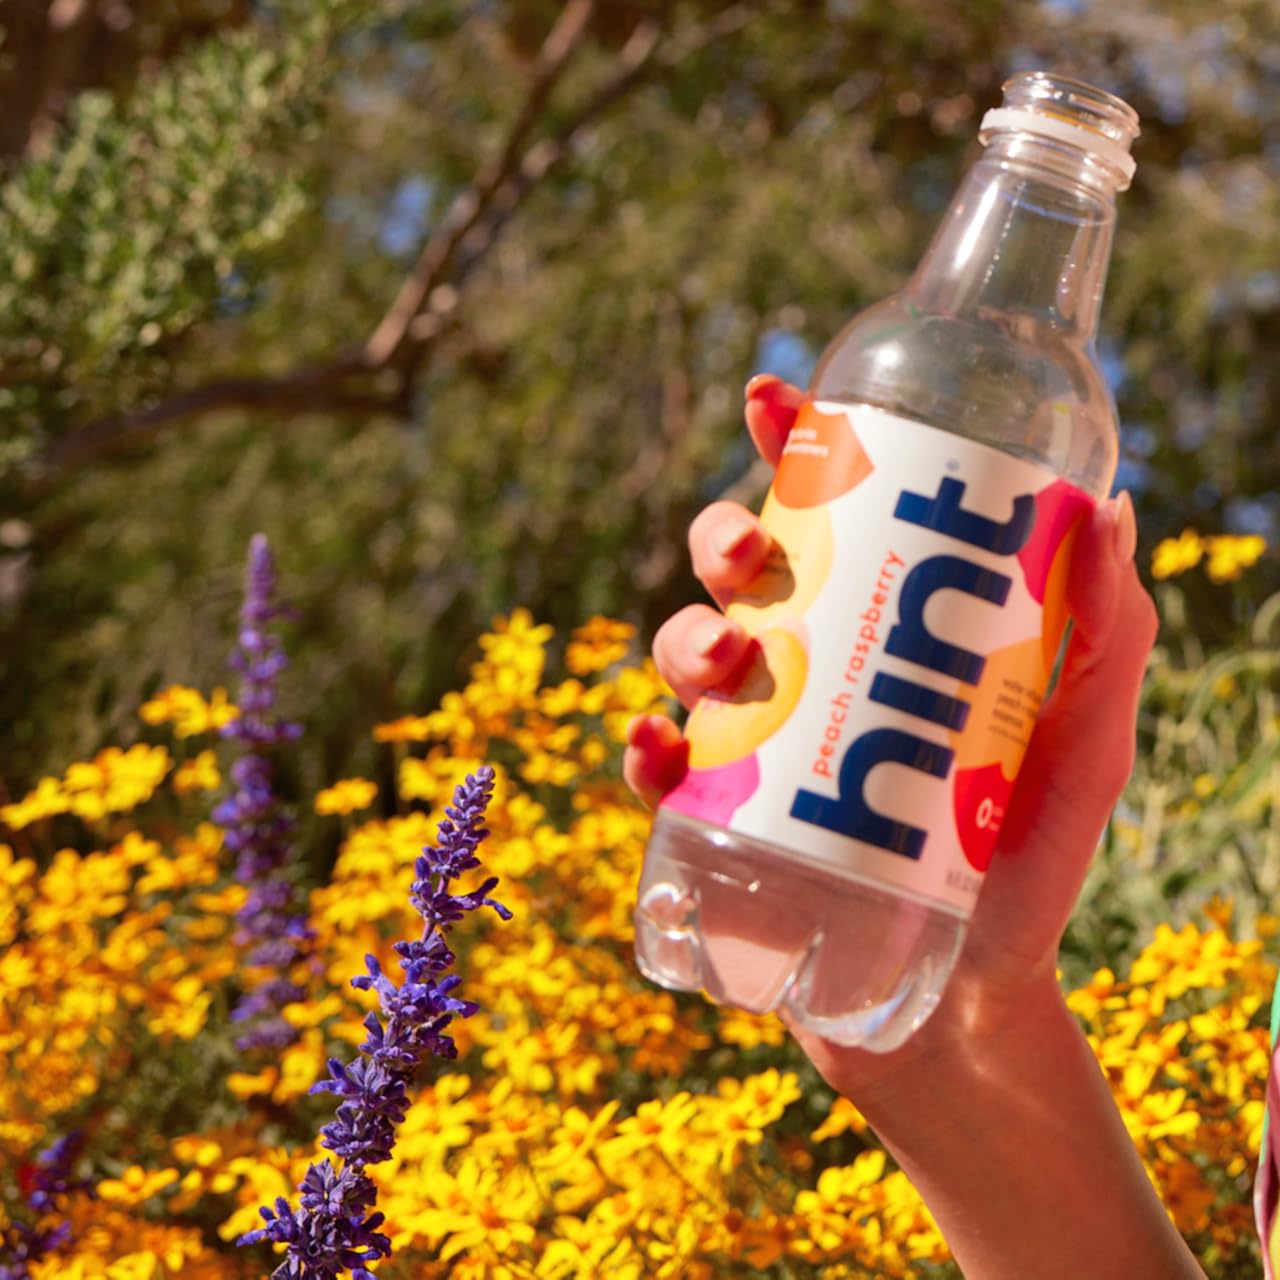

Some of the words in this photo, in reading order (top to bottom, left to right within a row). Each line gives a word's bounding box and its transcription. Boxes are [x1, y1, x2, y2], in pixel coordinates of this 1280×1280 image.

[789, 476, 1037, 862] hint
[811, 692, 854, 780] peach
[844, 549, 908, 686] raspberry
